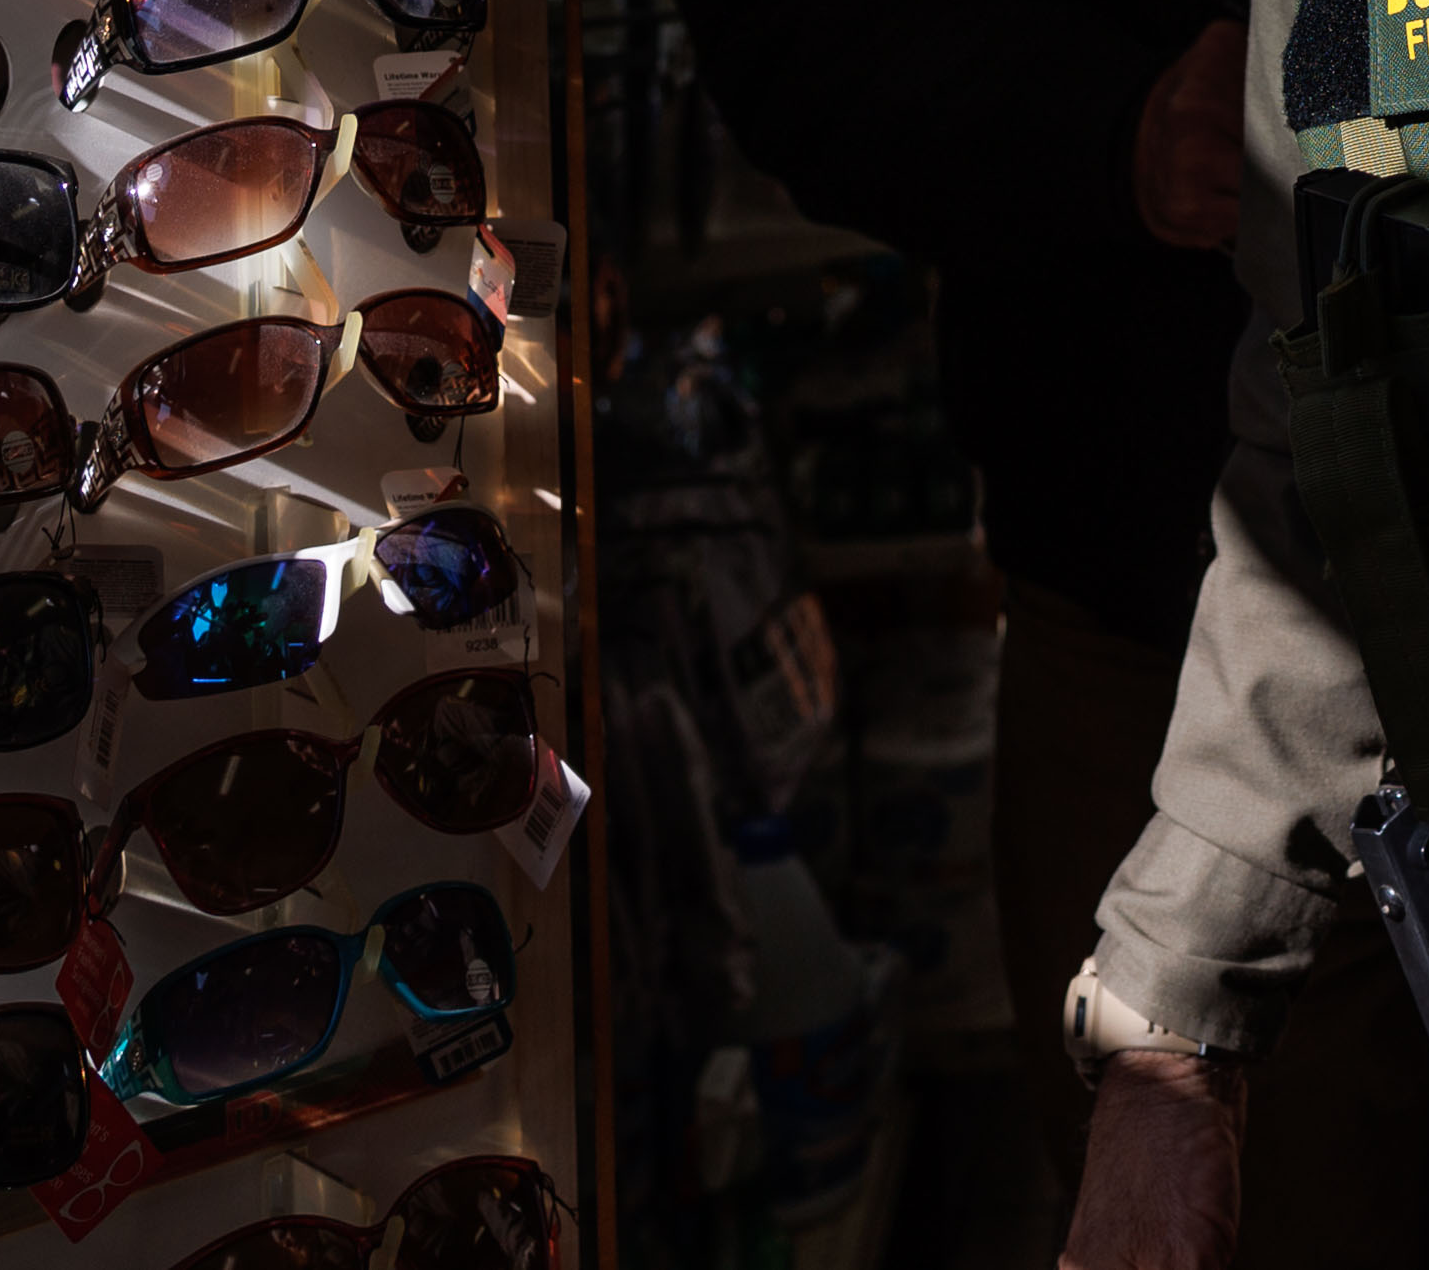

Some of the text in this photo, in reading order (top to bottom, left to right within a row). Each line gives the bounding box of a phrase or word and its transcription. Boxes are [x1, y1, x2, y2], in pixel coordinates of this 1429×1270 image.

[384, 72, 419, 82] Lifetime
[392, 492, 426, 502] Lifetime
[465, 636, 499, 652] 9238
